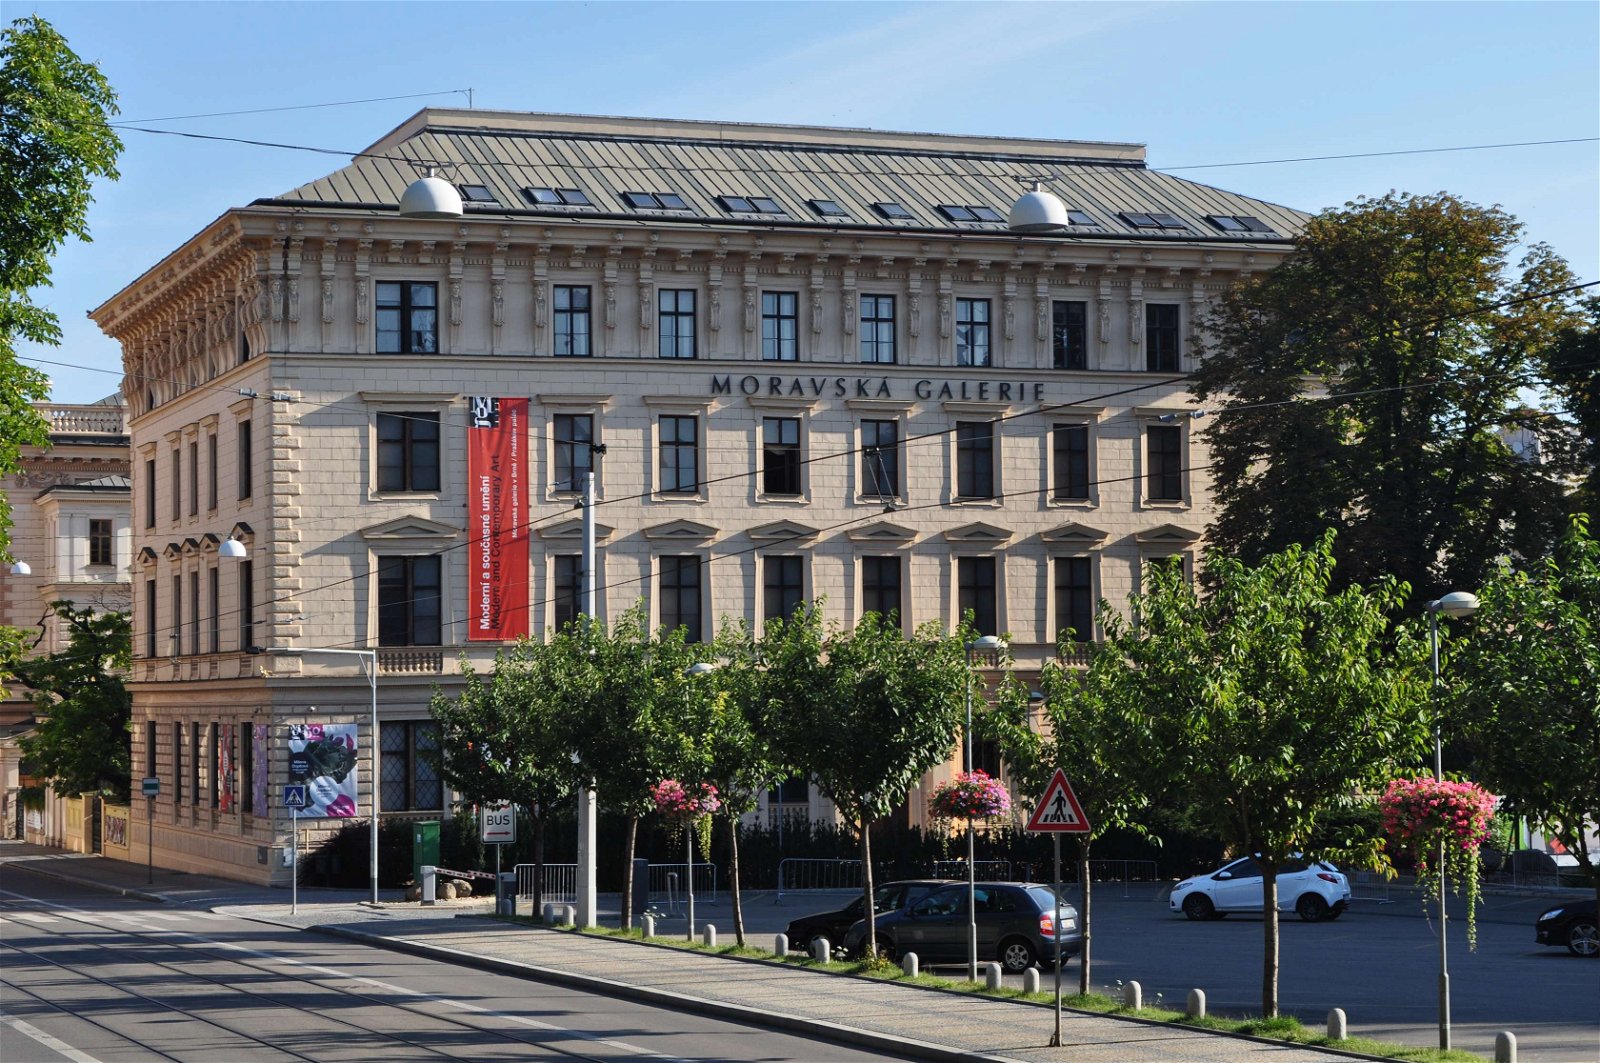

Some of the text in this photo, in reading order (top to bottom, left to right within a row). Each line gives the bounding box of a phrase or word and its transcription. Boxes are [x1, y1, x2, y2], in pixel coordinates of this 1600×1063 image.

[711, 375, 1045, 401] MORAVSKÁ GALERIE
[480, 475, 490, 511] umění
[480, 514, 490, 569] současné
[490, 455, 502, 630] Modern and Contemporary Art
[480, 582, 490, 630] Moderní
[487, 815, 510, 826] BUS
